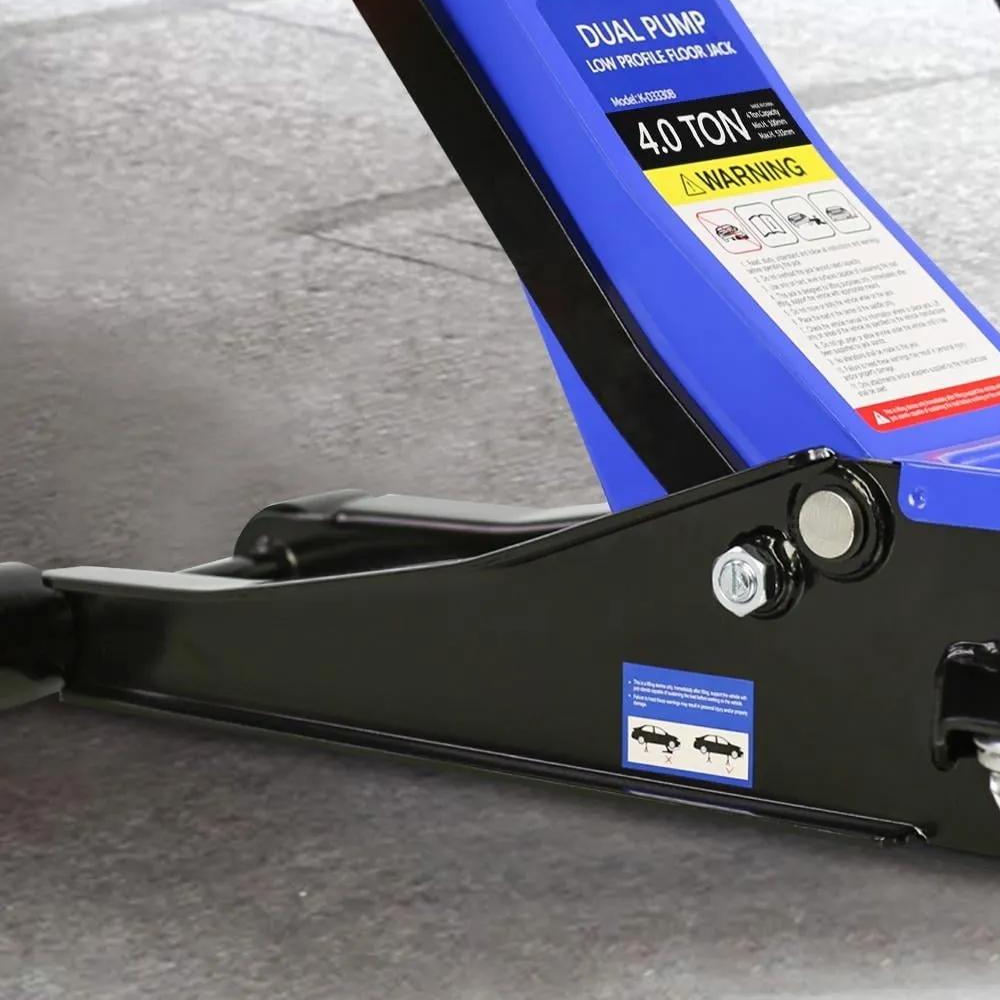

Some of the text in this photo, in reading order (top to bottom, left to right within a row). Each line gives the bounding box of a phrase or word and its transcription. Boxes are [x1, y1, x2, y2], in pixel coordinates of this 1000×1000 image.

[576, 10, 706, 48] DUAL PUMP
[586, 40, 737, 74] LOW PROFILE FLOOR JACK
[638, 107, 752, 155] 4.0 TON
[695, 157, 807, 192] WARNING
